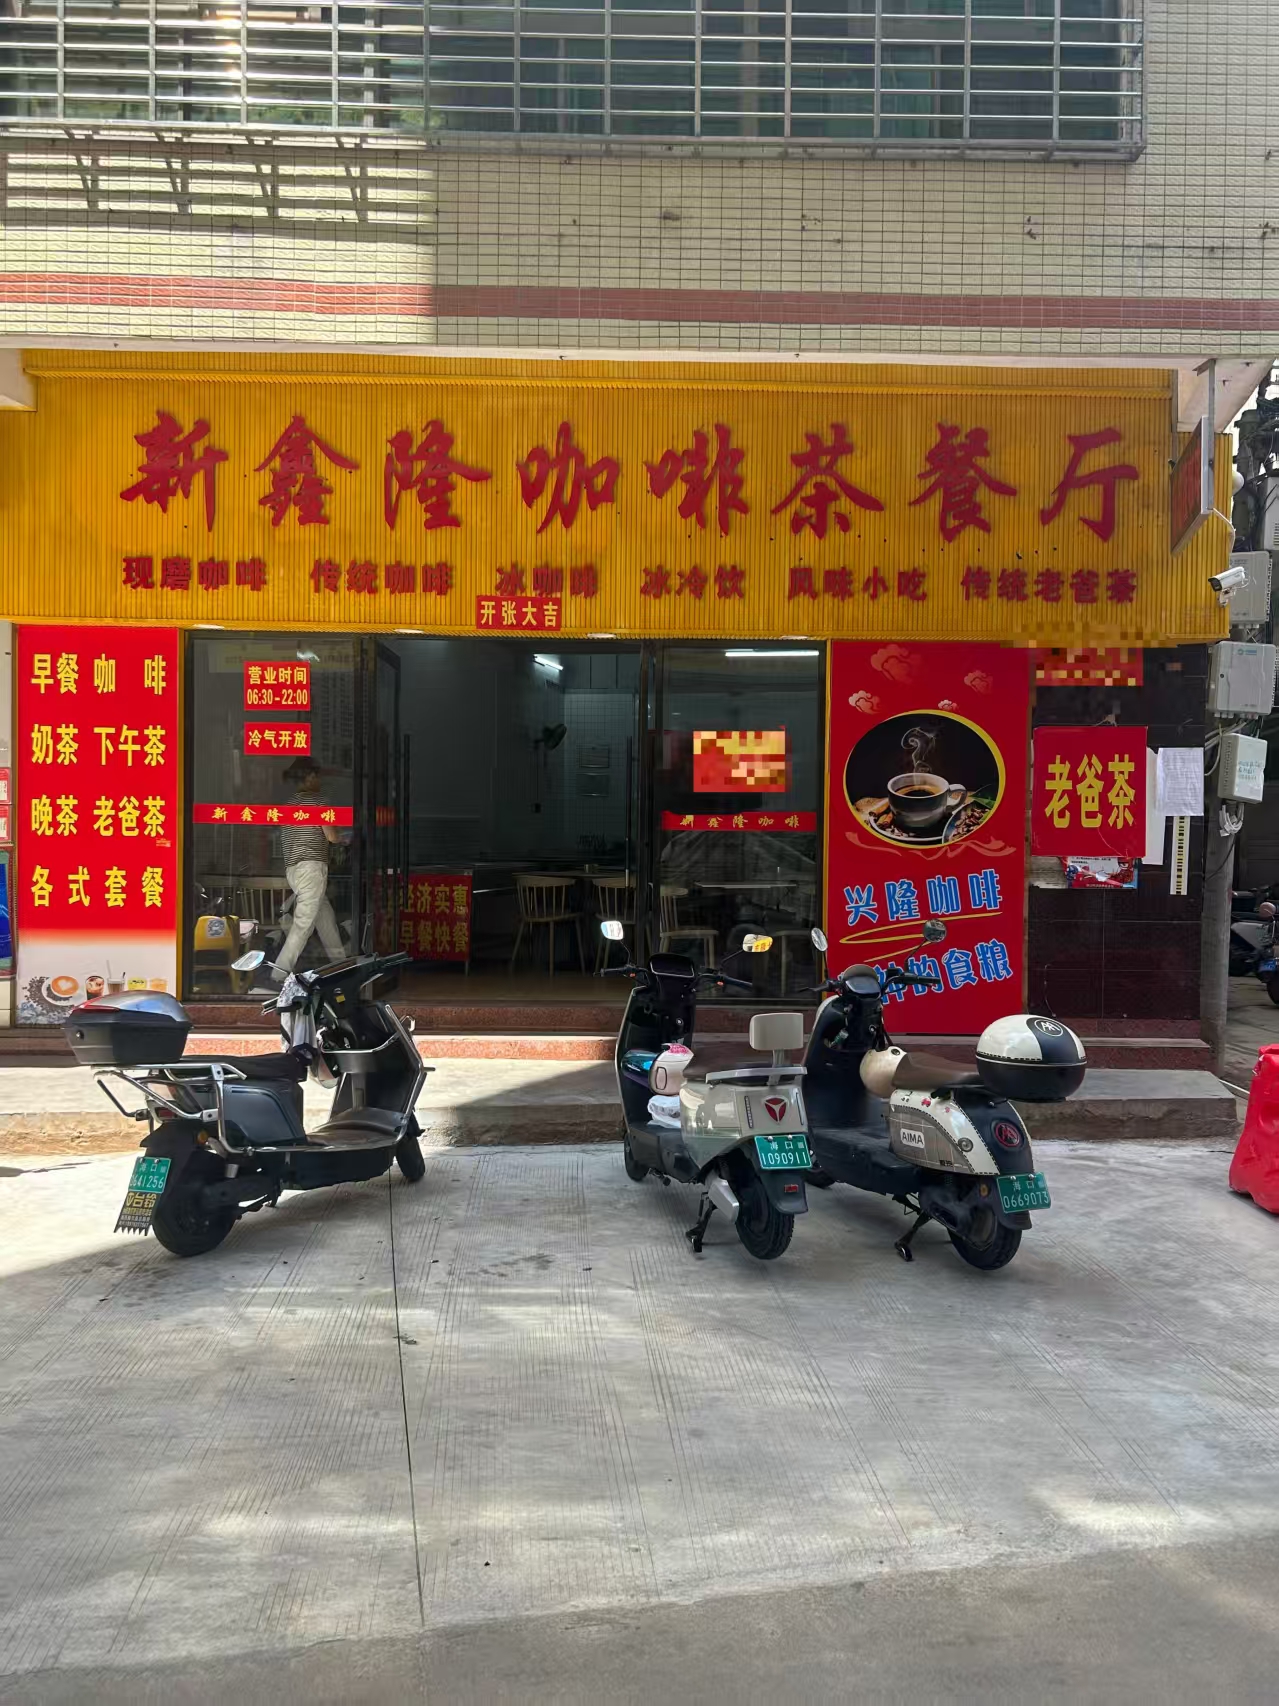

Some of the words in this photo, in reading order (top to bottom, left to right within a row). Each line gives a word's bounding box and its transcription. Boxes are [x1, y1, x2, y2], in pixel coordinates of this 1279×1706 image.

[119, 410, 1139, 543] 新鑫隆咖啡茶餐厅
[122, 557, 267, 592] 现磨咖啡
[310, 559, 453, 596] 传统咖啡
[640, 565, 746, 600] 冰冷饮
[788, 567, 927, 602] 风味小吃
[961, 567, 1138, 604] 传统老爸茶
[480, 599, 560, 628] 开张大吉
[31, 652, 79, 694] 早餐
[248, 666, 307, 685] 营业时间
[247, 688, 308, 705] 06:30-22:00
[31, 723, 79, 766] 奶茶
[93, 725, 167, 767] 下午茶
[247, 730, 308, 750] 冷气开放
[1045, 753, 1136, 830] 老爸茶
[31, 794, 79, 837] 晚茶
[93, 796, 166, 838] 老爸茶
[211, 807, 337, 823] 新鑫隆咖啡
[31, 865, 165, 908] 各式套餐
[843, 869, 1003, 926] 兴隆咖啡
[901, 1131, 924, 1145] AIMA
[761, 1151, 807, 1165] 1090911
[1003, 1190, 1049, 1209] 0669073
[1012, 1180, 1035, 1191] 海口
